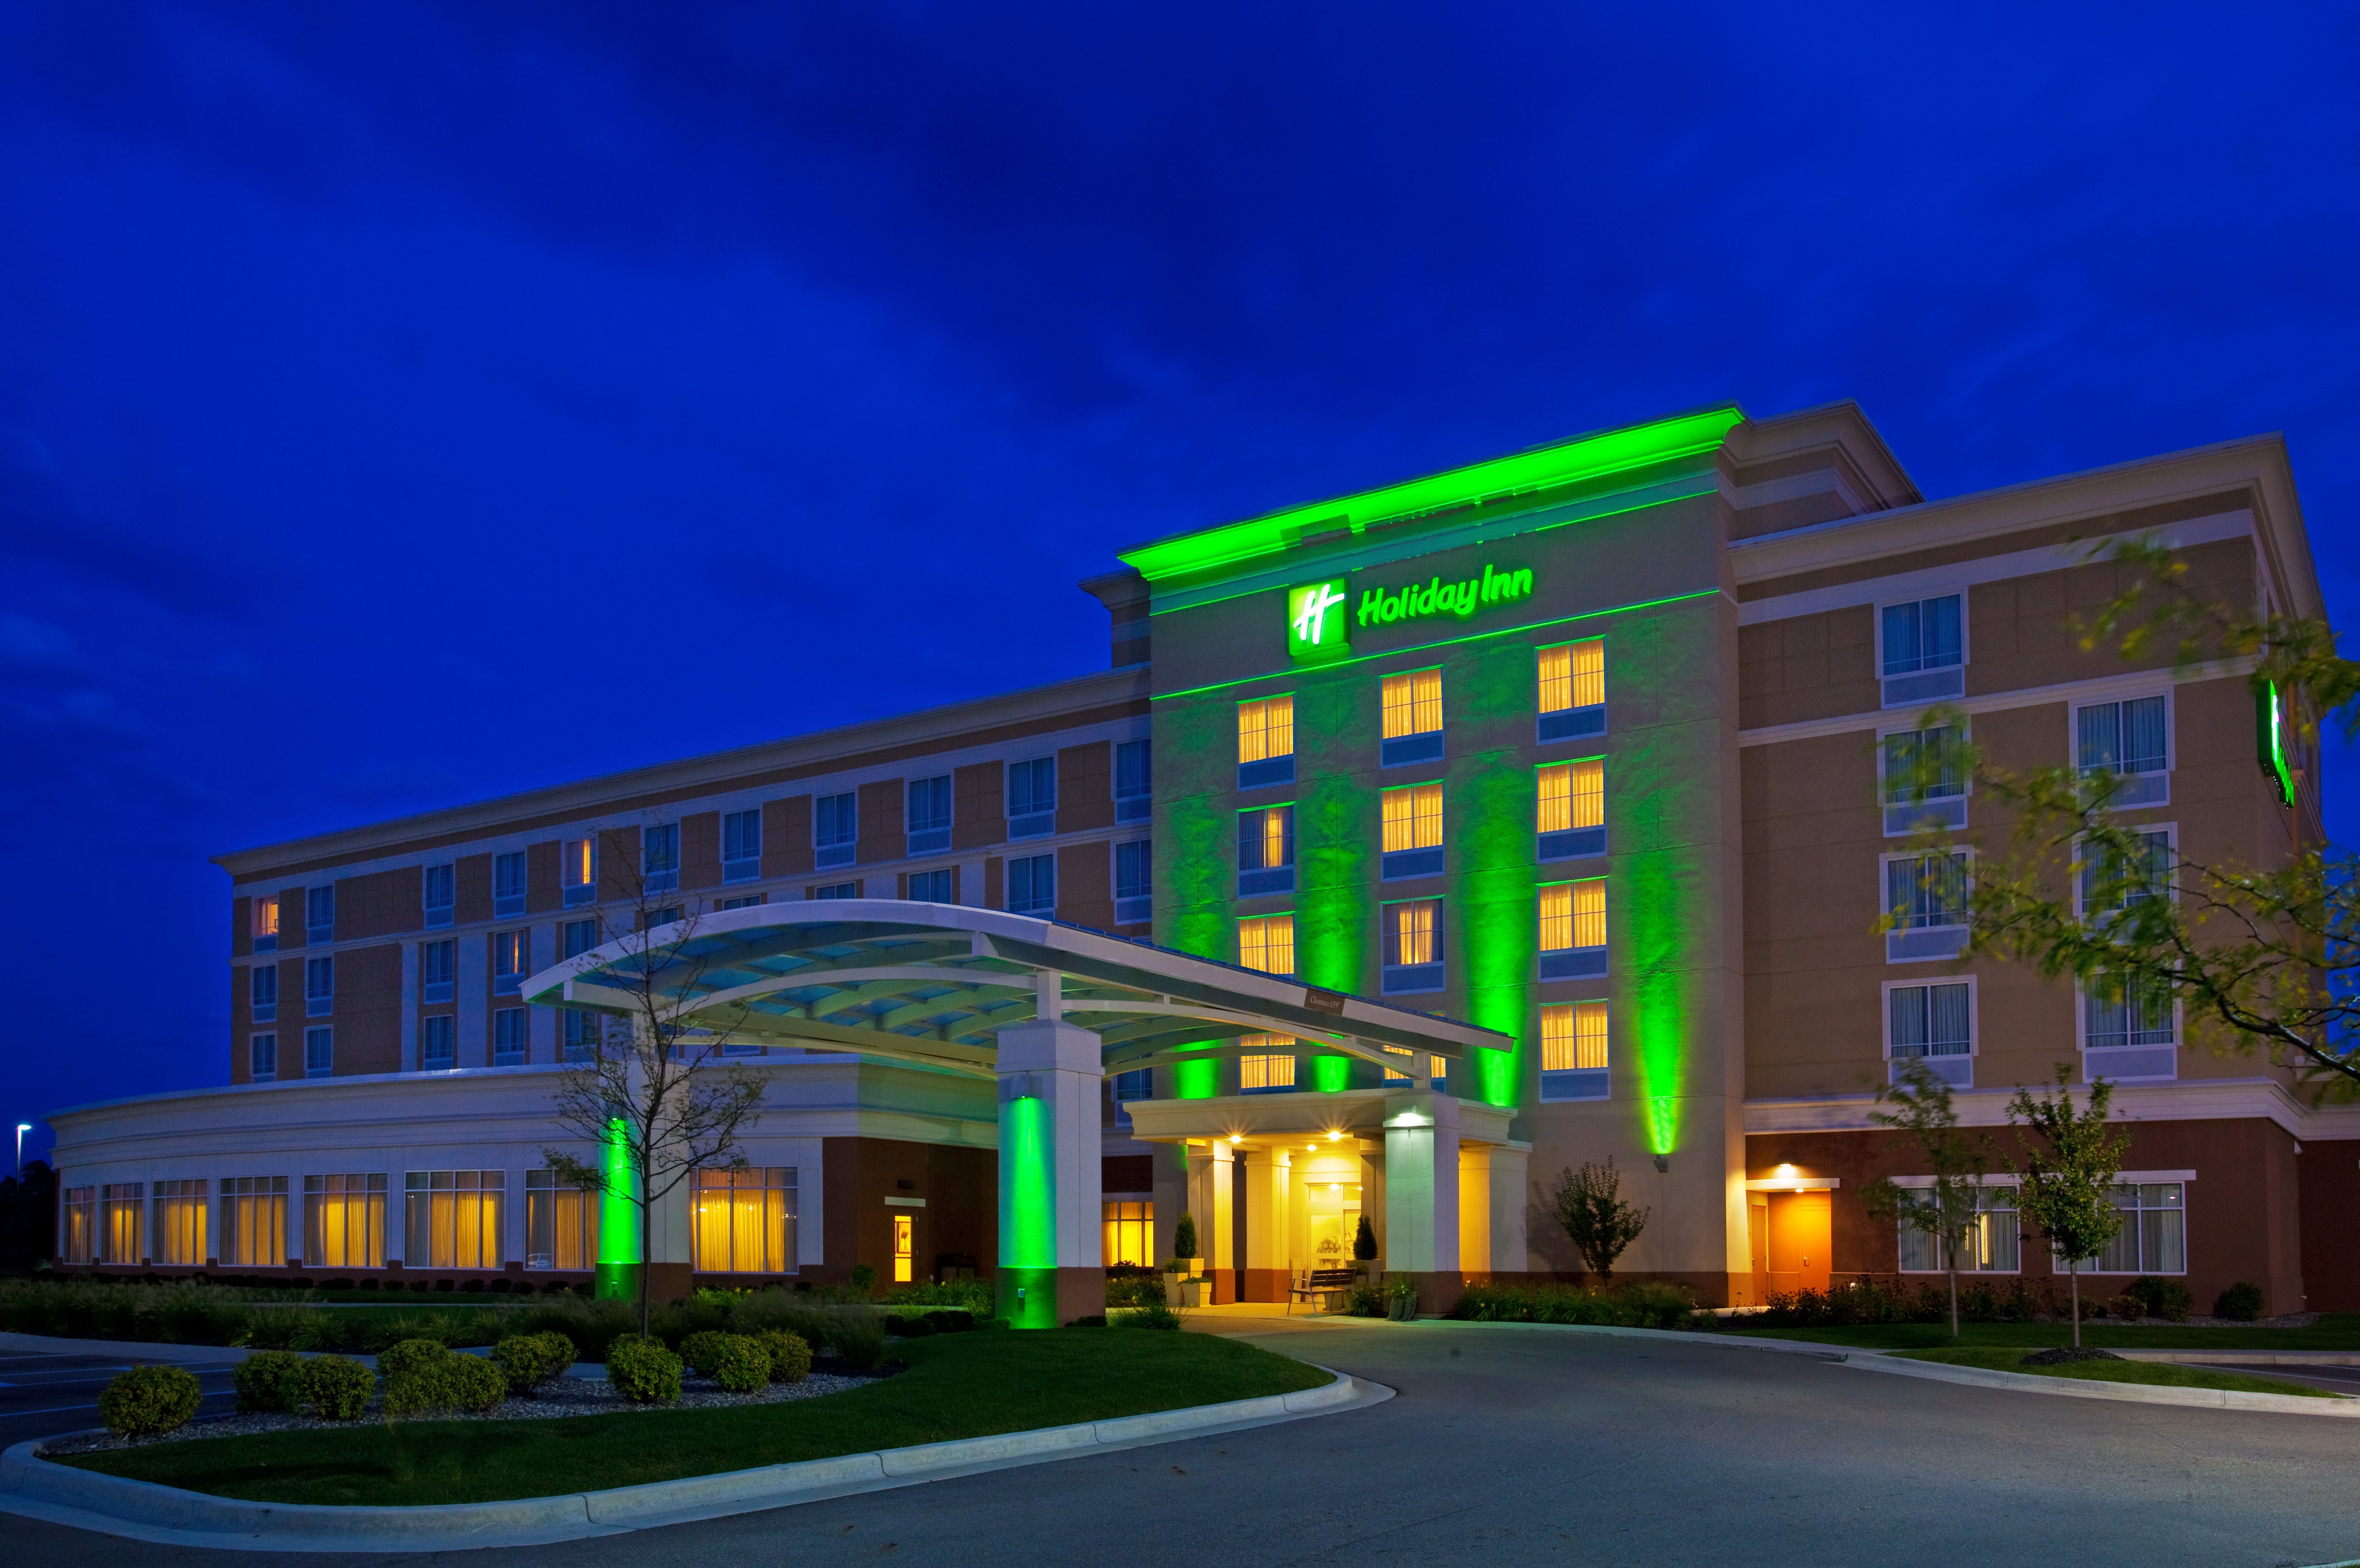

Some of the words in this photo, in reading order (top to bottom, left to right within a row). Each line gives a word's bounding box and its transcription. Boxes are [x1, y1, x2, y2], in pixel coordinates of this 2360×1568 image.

[1357, 577, 1478, 626] Holiday
[1481, 564, 1533, 602] Inn
[1310, 995, 1330, 1007] Clearance
